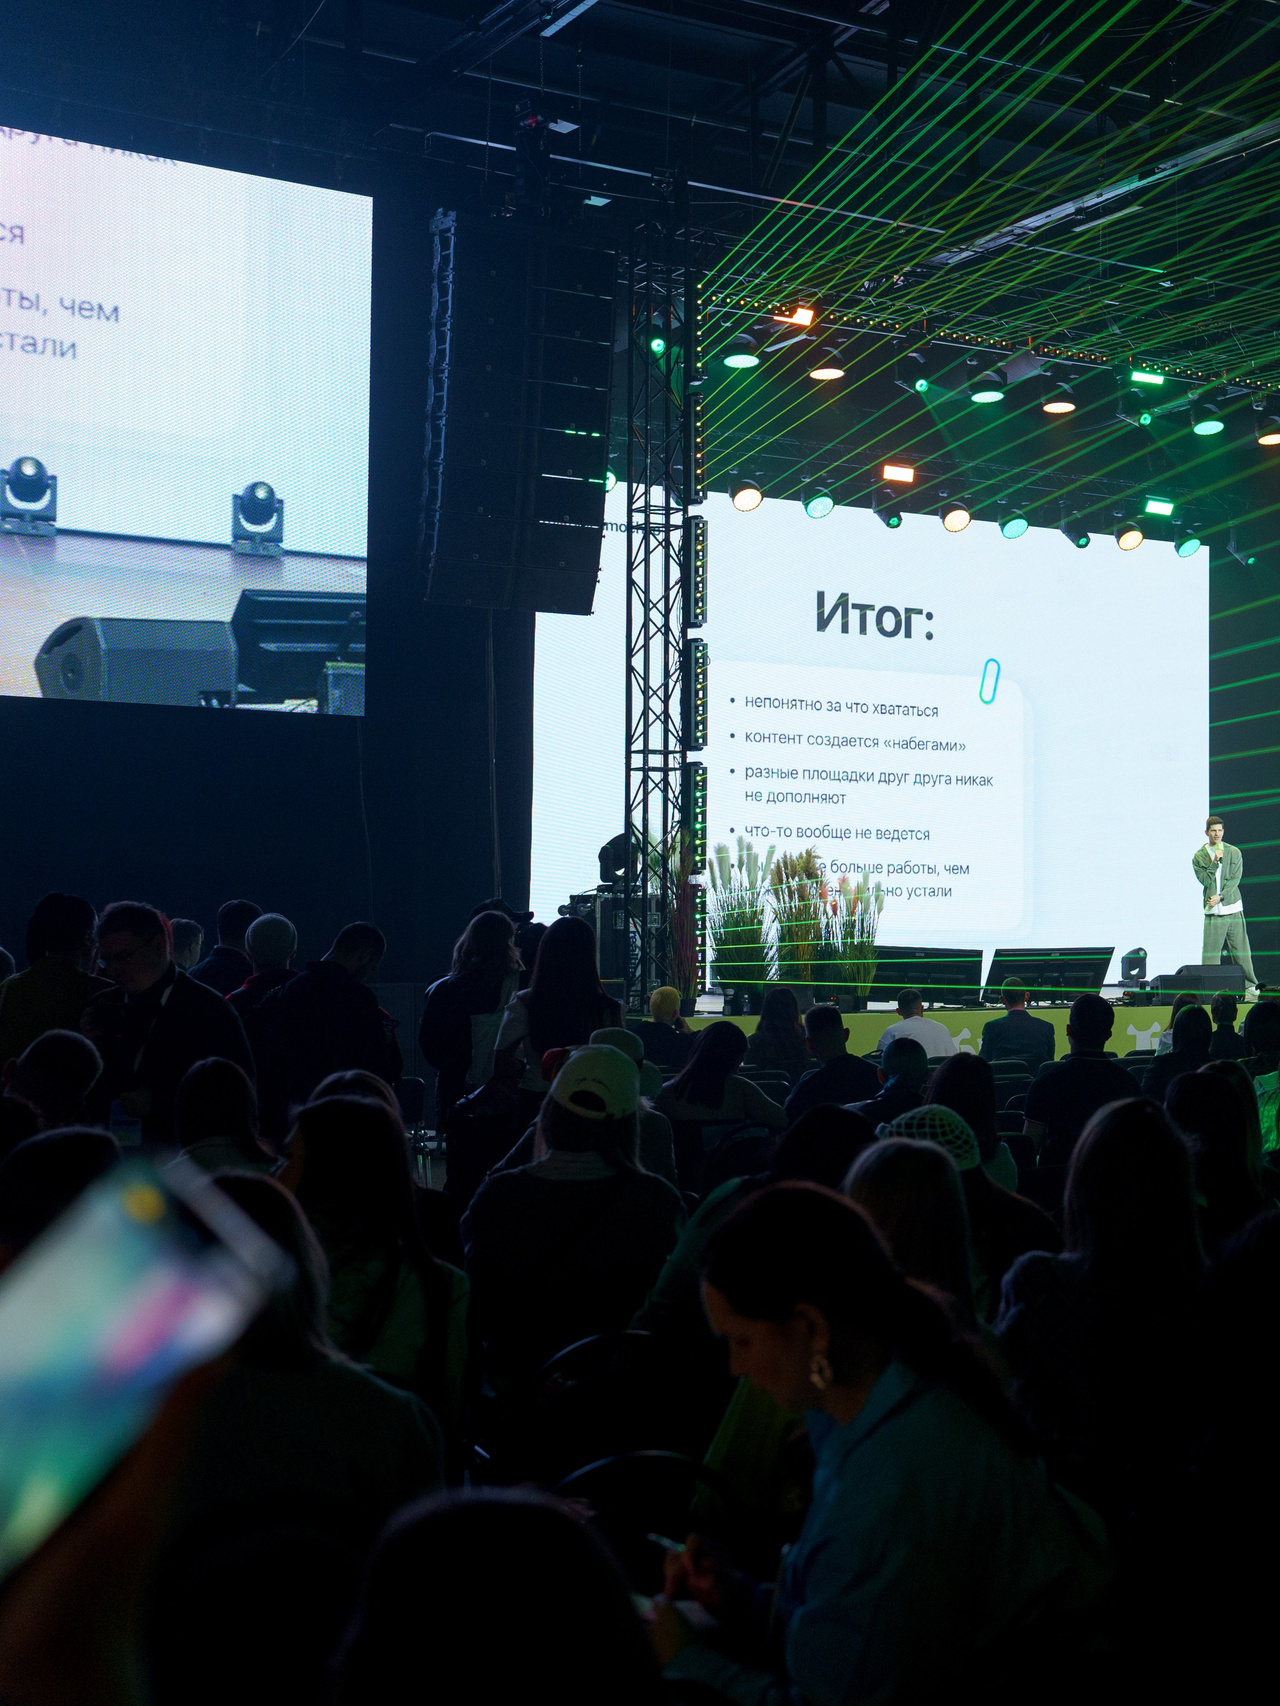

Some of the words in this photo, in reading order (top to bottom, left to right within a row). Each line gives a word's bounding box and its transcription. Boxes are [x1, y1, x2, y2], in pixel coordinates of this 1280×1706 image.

[59, 296, 119, 322] чем
[0, 331, 76, 359] тали
[817, 591, 933, 640] Итог:
[746, 697, 822, 711] непонятно
[827, 701, 841, 712] за
[846, 702, 868, 713] что
[873, 704, 938, 717] хвататься
[746, 732, 803, 744] контент
[807, 735, 878, 748] создается
[884, 737, 965, 751] «набегами»
[746, 767, 798, 780] разные
[803, 769, 874, 783] площадки
[878, 772, 909, 786] друг
[914, 774, 951, 787] друга
[956, 776, 993, 786] никак
[746, 791, 762, 802] не
[767, 792, 846, 804] дополняют
[745, 826, 792, 837] что-то
[797, 825, 851, 841] вообще
[856, 829, 871, 839] не
[876, 829, 929, 842] ведется
[829, 859, 884, 874] больше
[888, 860, 939, 876] работы,
[944, 865, 969, 874] чем
[907, 887, 951, 900] устали
